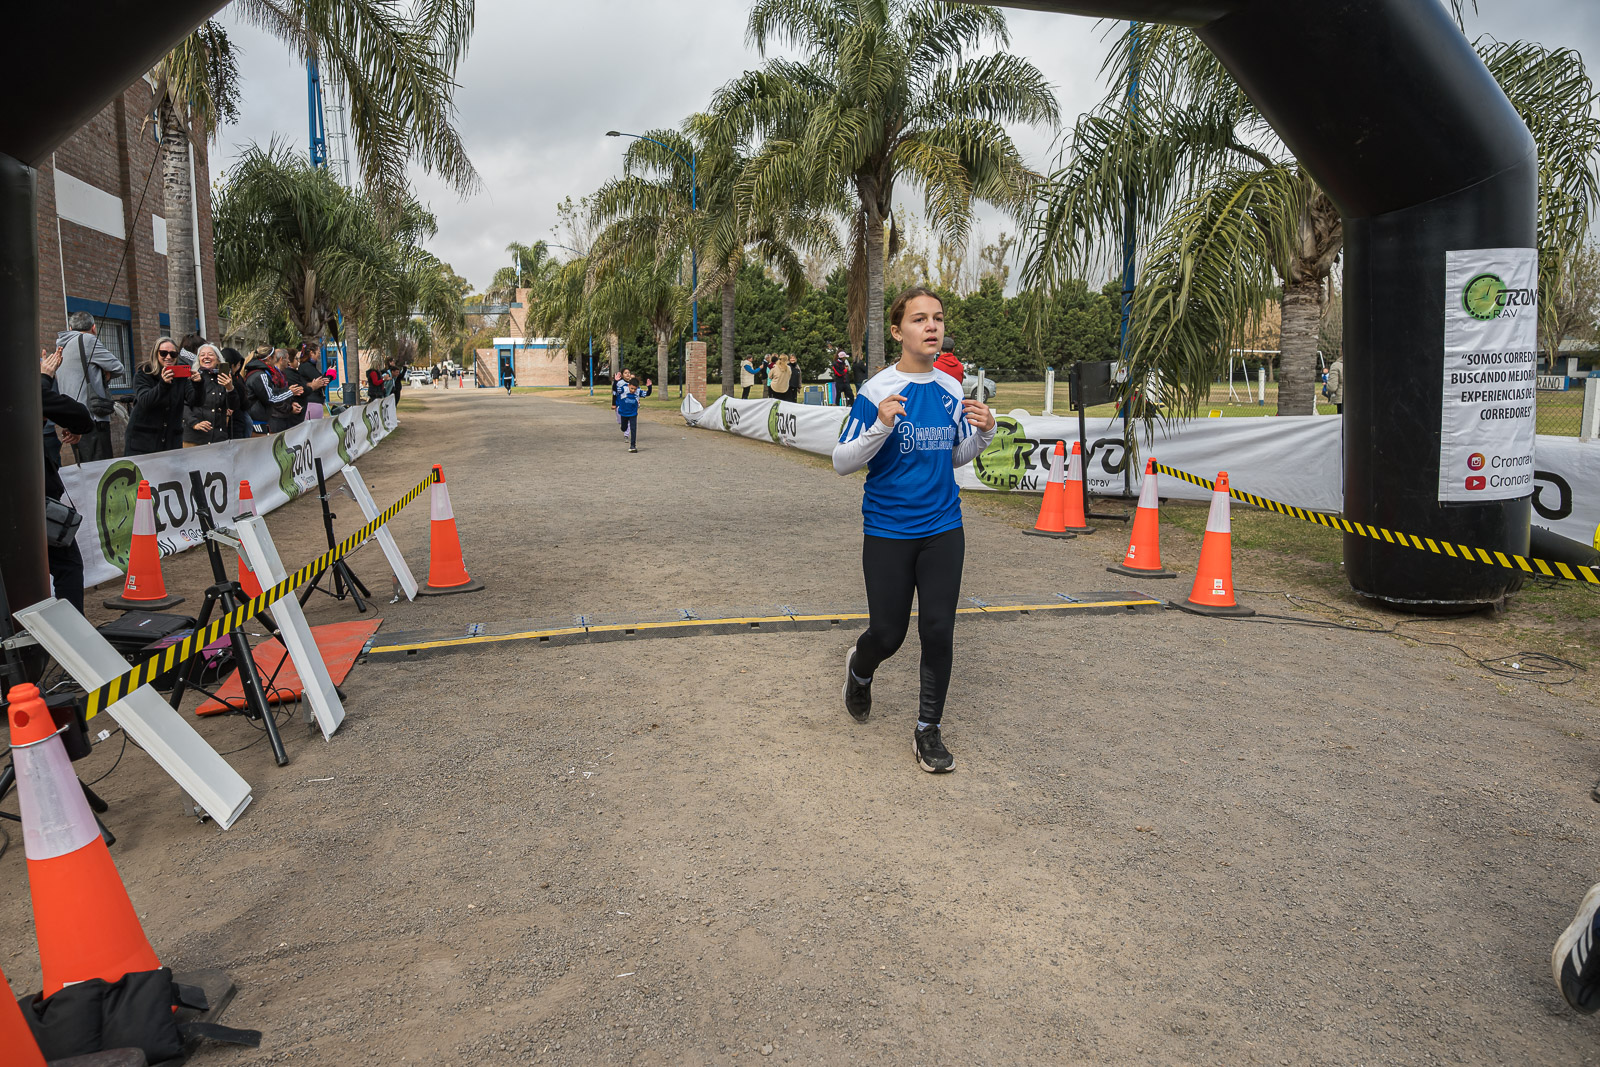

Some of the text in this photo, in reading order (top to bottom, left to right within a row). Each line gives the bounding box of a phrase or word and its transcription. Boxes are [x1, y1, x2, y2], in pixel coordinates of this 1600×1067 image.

[1494, 309, 1518, 318] RAV
[1451, 371, 1506, 384] BUSCANDO
[1461, 388, 1525, 402] EXPERIENCIAS
[1526, 388, 1532, 399] DE
[898, 421, 915, 454] 3
[1008, 474, 1039, 490] RAV
